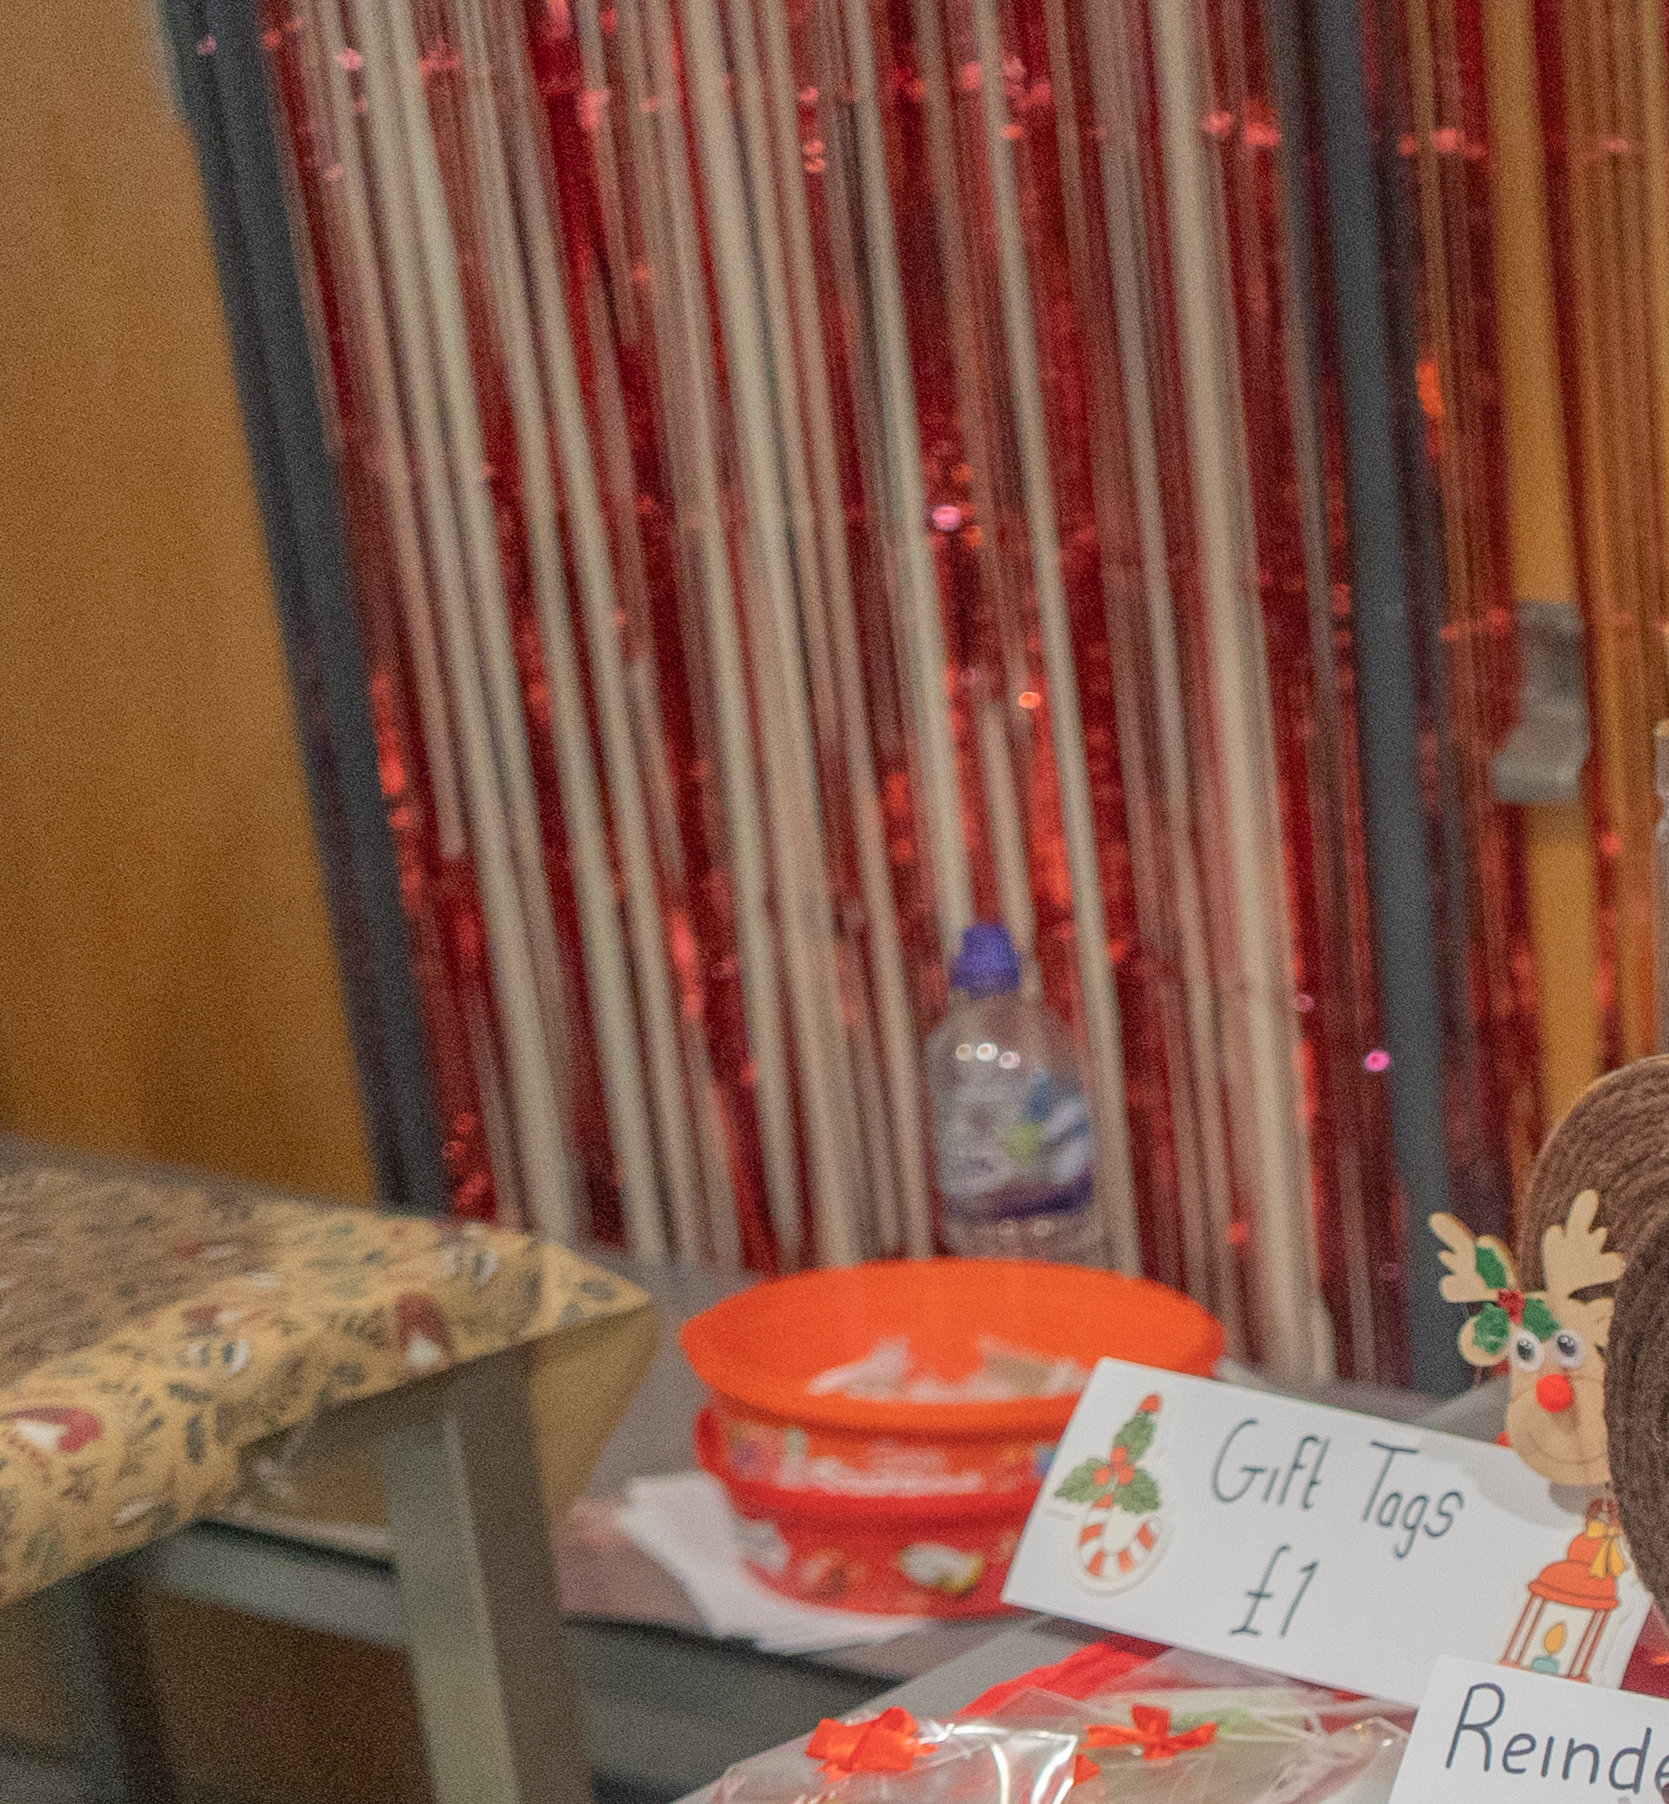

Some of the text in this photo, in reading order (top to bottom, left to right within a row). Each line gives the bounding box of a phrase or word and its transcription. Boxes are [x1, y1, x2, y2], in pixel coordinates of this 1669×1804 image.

[1211, 1418, 1466, 1559] Gift Tags
[1229, 1544, 1319, 1638] £1
